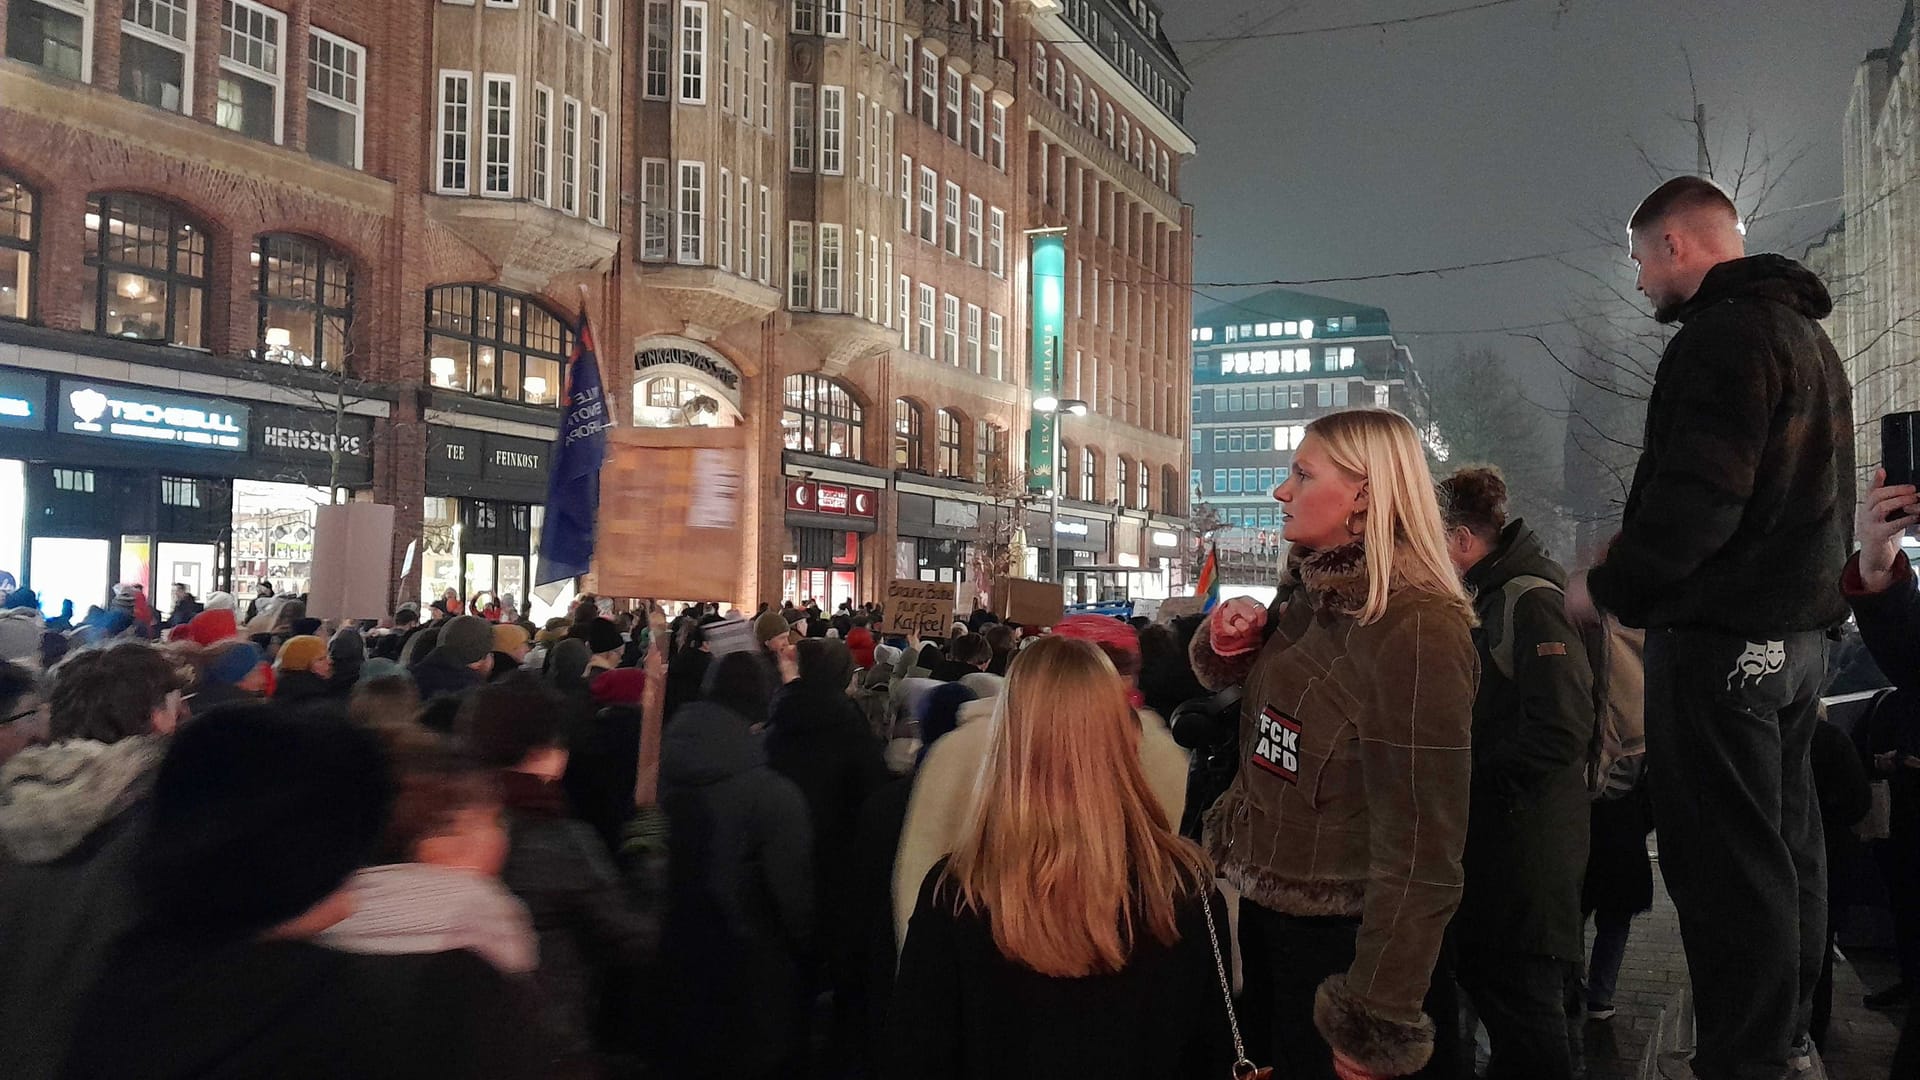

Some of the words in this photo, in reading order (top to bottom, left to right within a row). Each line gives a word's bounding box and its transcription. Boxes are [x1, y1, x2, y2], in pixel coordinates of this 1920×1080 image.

[447, 444, 465, 460] TEE
[496, 450, 538, 469] FEINKOST
[897, 601, 918, 612] nur
[894, 613, 945, 636] Kaffee!
[1260, 713, 1298, 752] FCK
[1255, 736, 1297, 772] AFD
